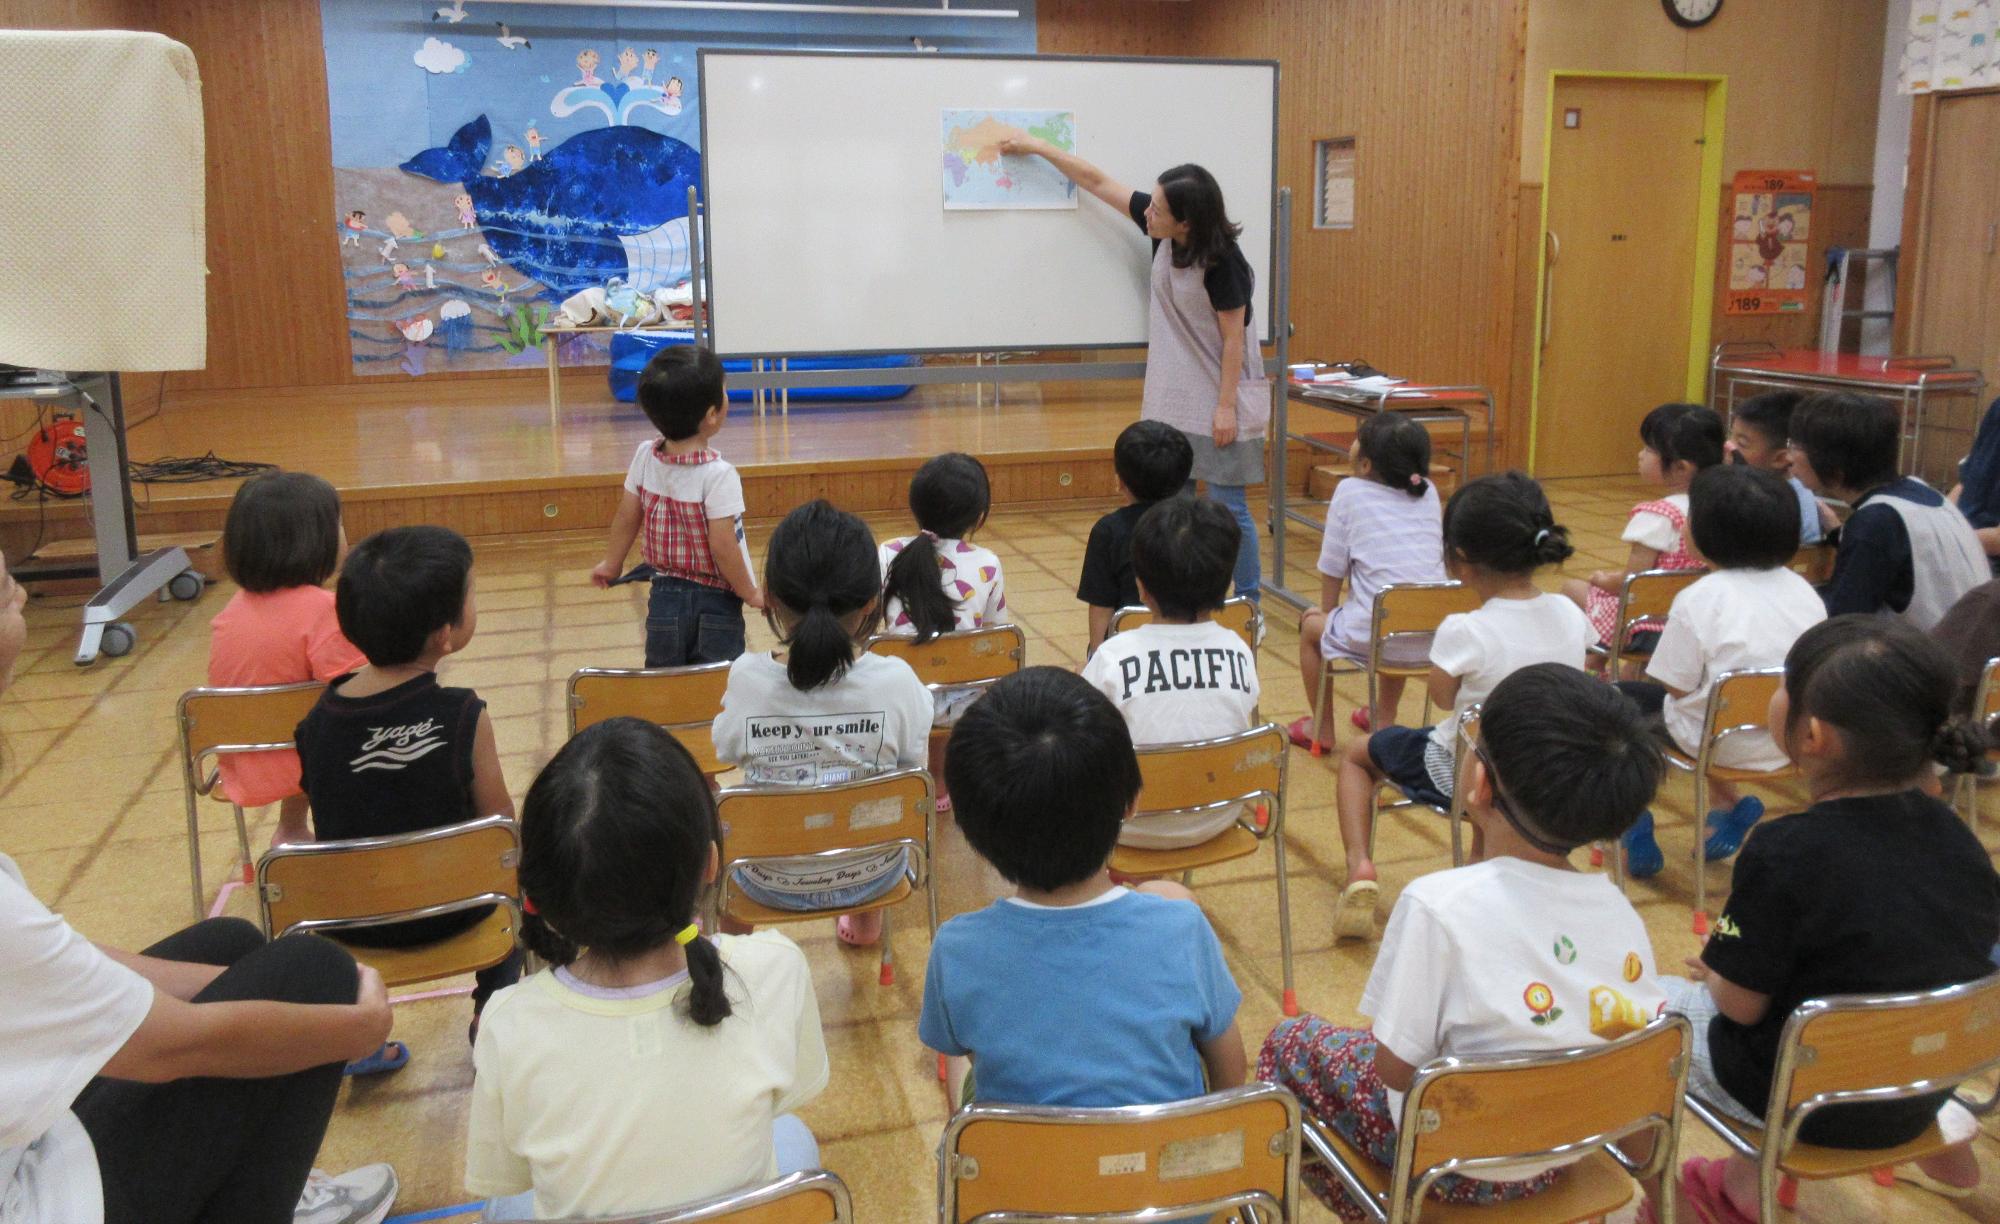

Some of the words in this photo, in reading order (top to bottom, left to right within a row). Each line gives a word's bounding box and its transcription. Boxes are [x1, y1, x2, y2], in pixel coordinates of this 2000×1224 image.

[1763, 179, 1785, 191] 189
[1736, 297, 1761, 311] 189
[1119, 648, 1251, 700] PACIFIC
[751, 723, 792, 739] Keep
[835, 718, 880, 735] smile
[768, 755, 778, 763] SEE
[751, 865, 772, 881] Days
[836, 869, 862, 880] Days
